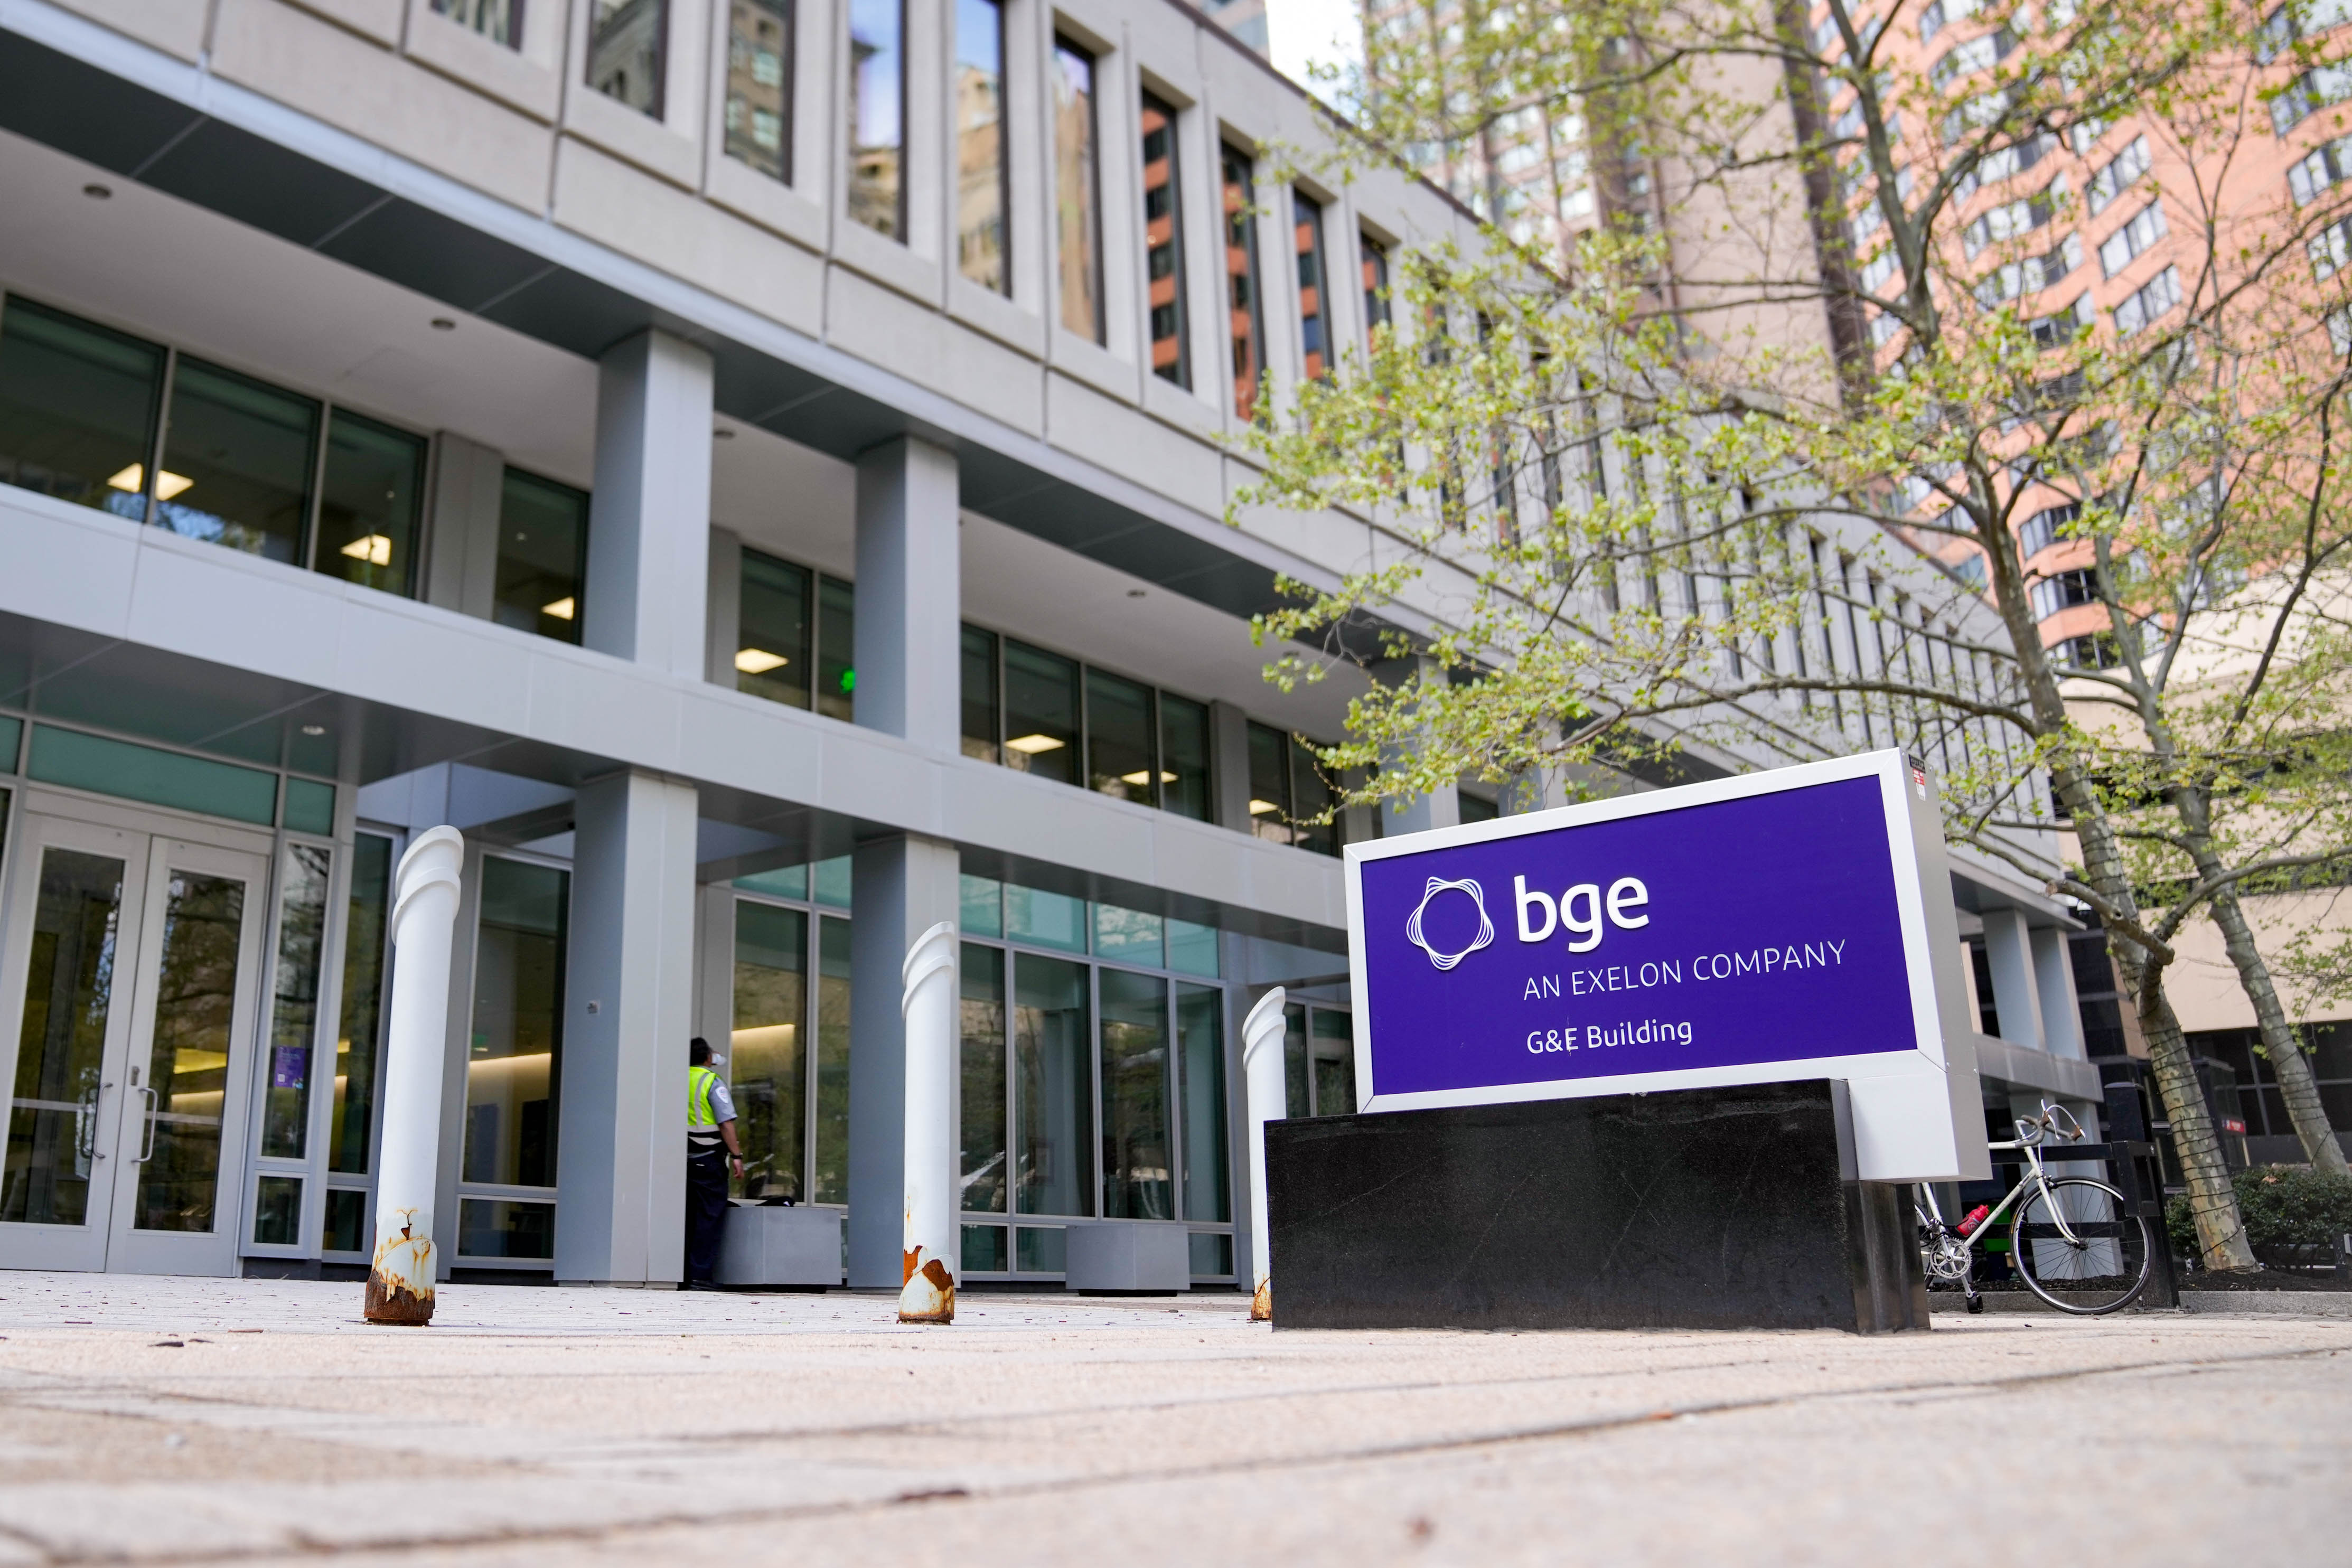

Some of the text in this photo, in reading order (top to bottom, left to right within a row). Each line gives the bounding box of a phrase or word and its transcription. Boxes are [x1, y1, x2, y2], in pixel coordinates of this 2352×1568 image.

[1514, 875, 1649, 953] bge
[1524, 938, 1845, 1000] AN EXELON COMPANY
[1527, 1018, 1692, 1054] G&E Building
